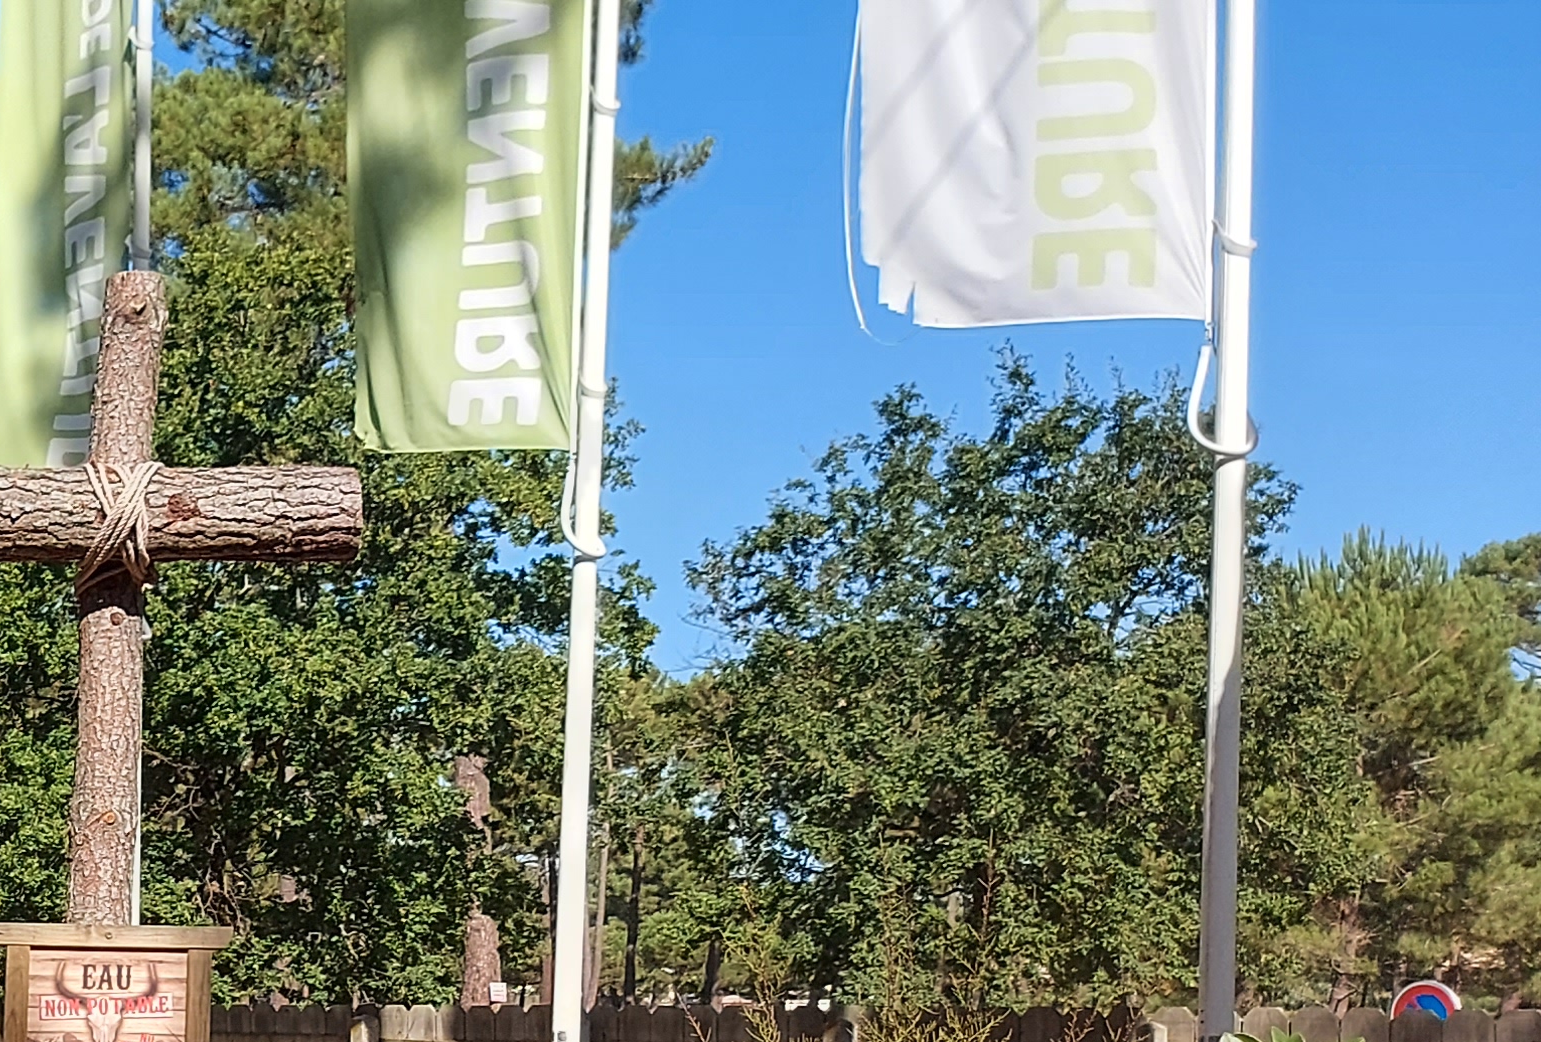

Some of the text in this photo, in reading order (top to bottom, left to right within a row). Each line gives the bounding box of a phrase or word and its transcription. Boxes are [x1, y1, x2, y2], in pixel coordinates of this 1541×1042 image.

[81, 964, 133, 990] EAU
[45, 995, 170, 1017] NON POTABLE
